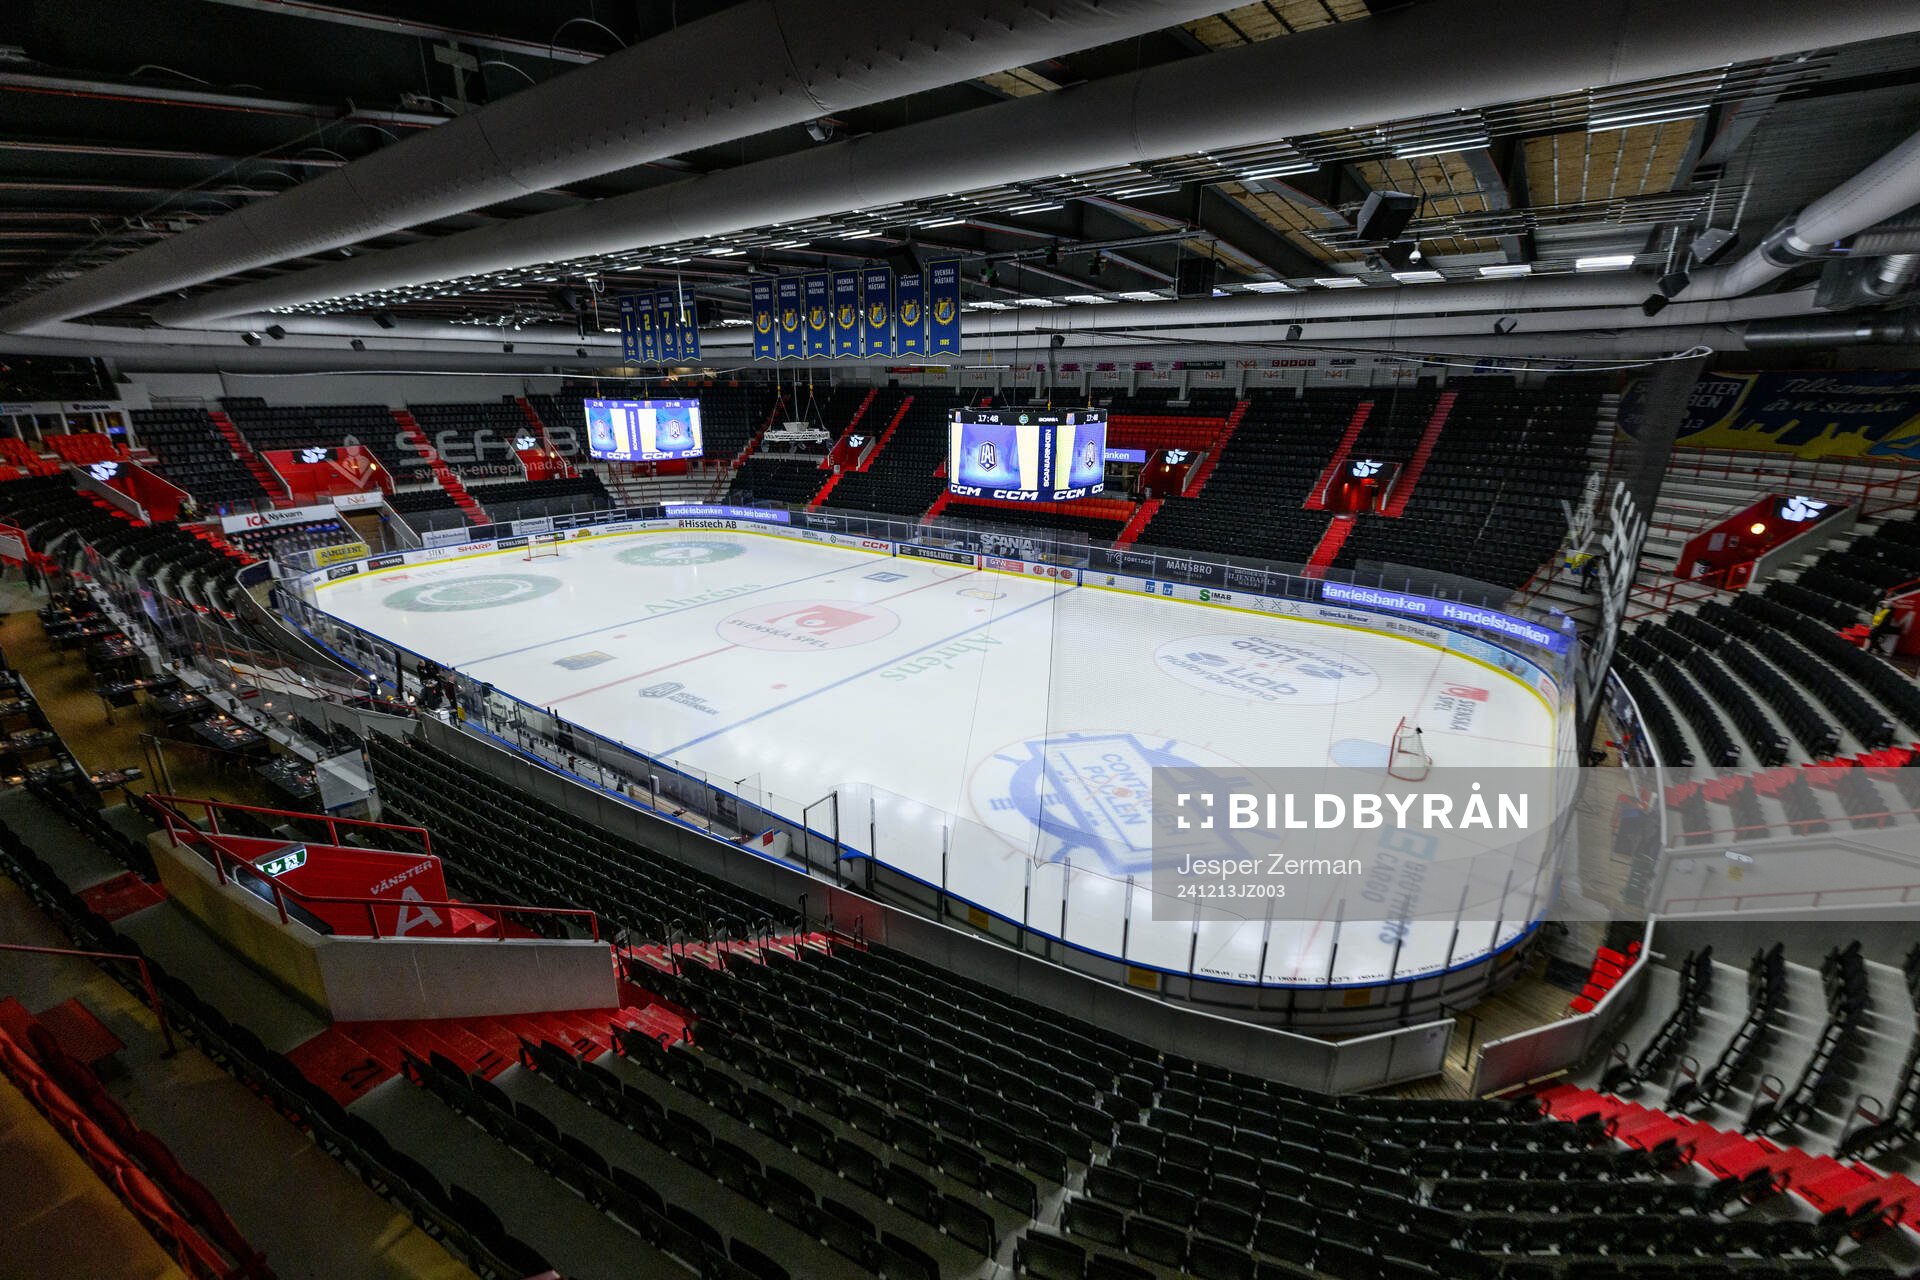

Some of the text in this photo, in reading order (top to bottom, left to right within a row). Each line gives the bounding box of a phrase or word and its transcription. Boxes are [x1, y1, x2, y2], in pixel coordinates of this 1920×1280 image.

[934, 268, 954, 277] SVENSKA
[643, 313, 651, 330] 2
[663, 311, 670, 329] 7
[977, 414, 999, 423] 17:48
[395, 425, 579, 467] SEFAB
[606, 452, 631, 460] CCM
[642, 451, 673, 460] CCM
[951, 484, 982, 497] CCM
[993, 490, 1039, 501] CCM
[1053, 487, 1086, 501] CCM
[245, 515, 269, 527] ICA
[685, 519, 723, 529] Hisstech
[725, 519, 737, 529] AB
[457, 542, 492, 553] SHARP
[862, 540, 889, 550] CCM
[979, 534, 1034, 551] SCANIA
[1166, 560, 1213, 575] MÅNSBRO
[1323, 585, 1426, 612] Handelsbanken
[1442, 604, 1550, 645] Handelsbanken
[727, 618, 831, 649] SVENSKA SPEL
[1224, 666, 1299, 696] Liab
[1449, 700, 1477, 732] SVENSKA
[370, 860, 433, 896] VÄNSTER
[1360, 851, 1400, 905] CARGO
[394, 885, 443, 937] A
